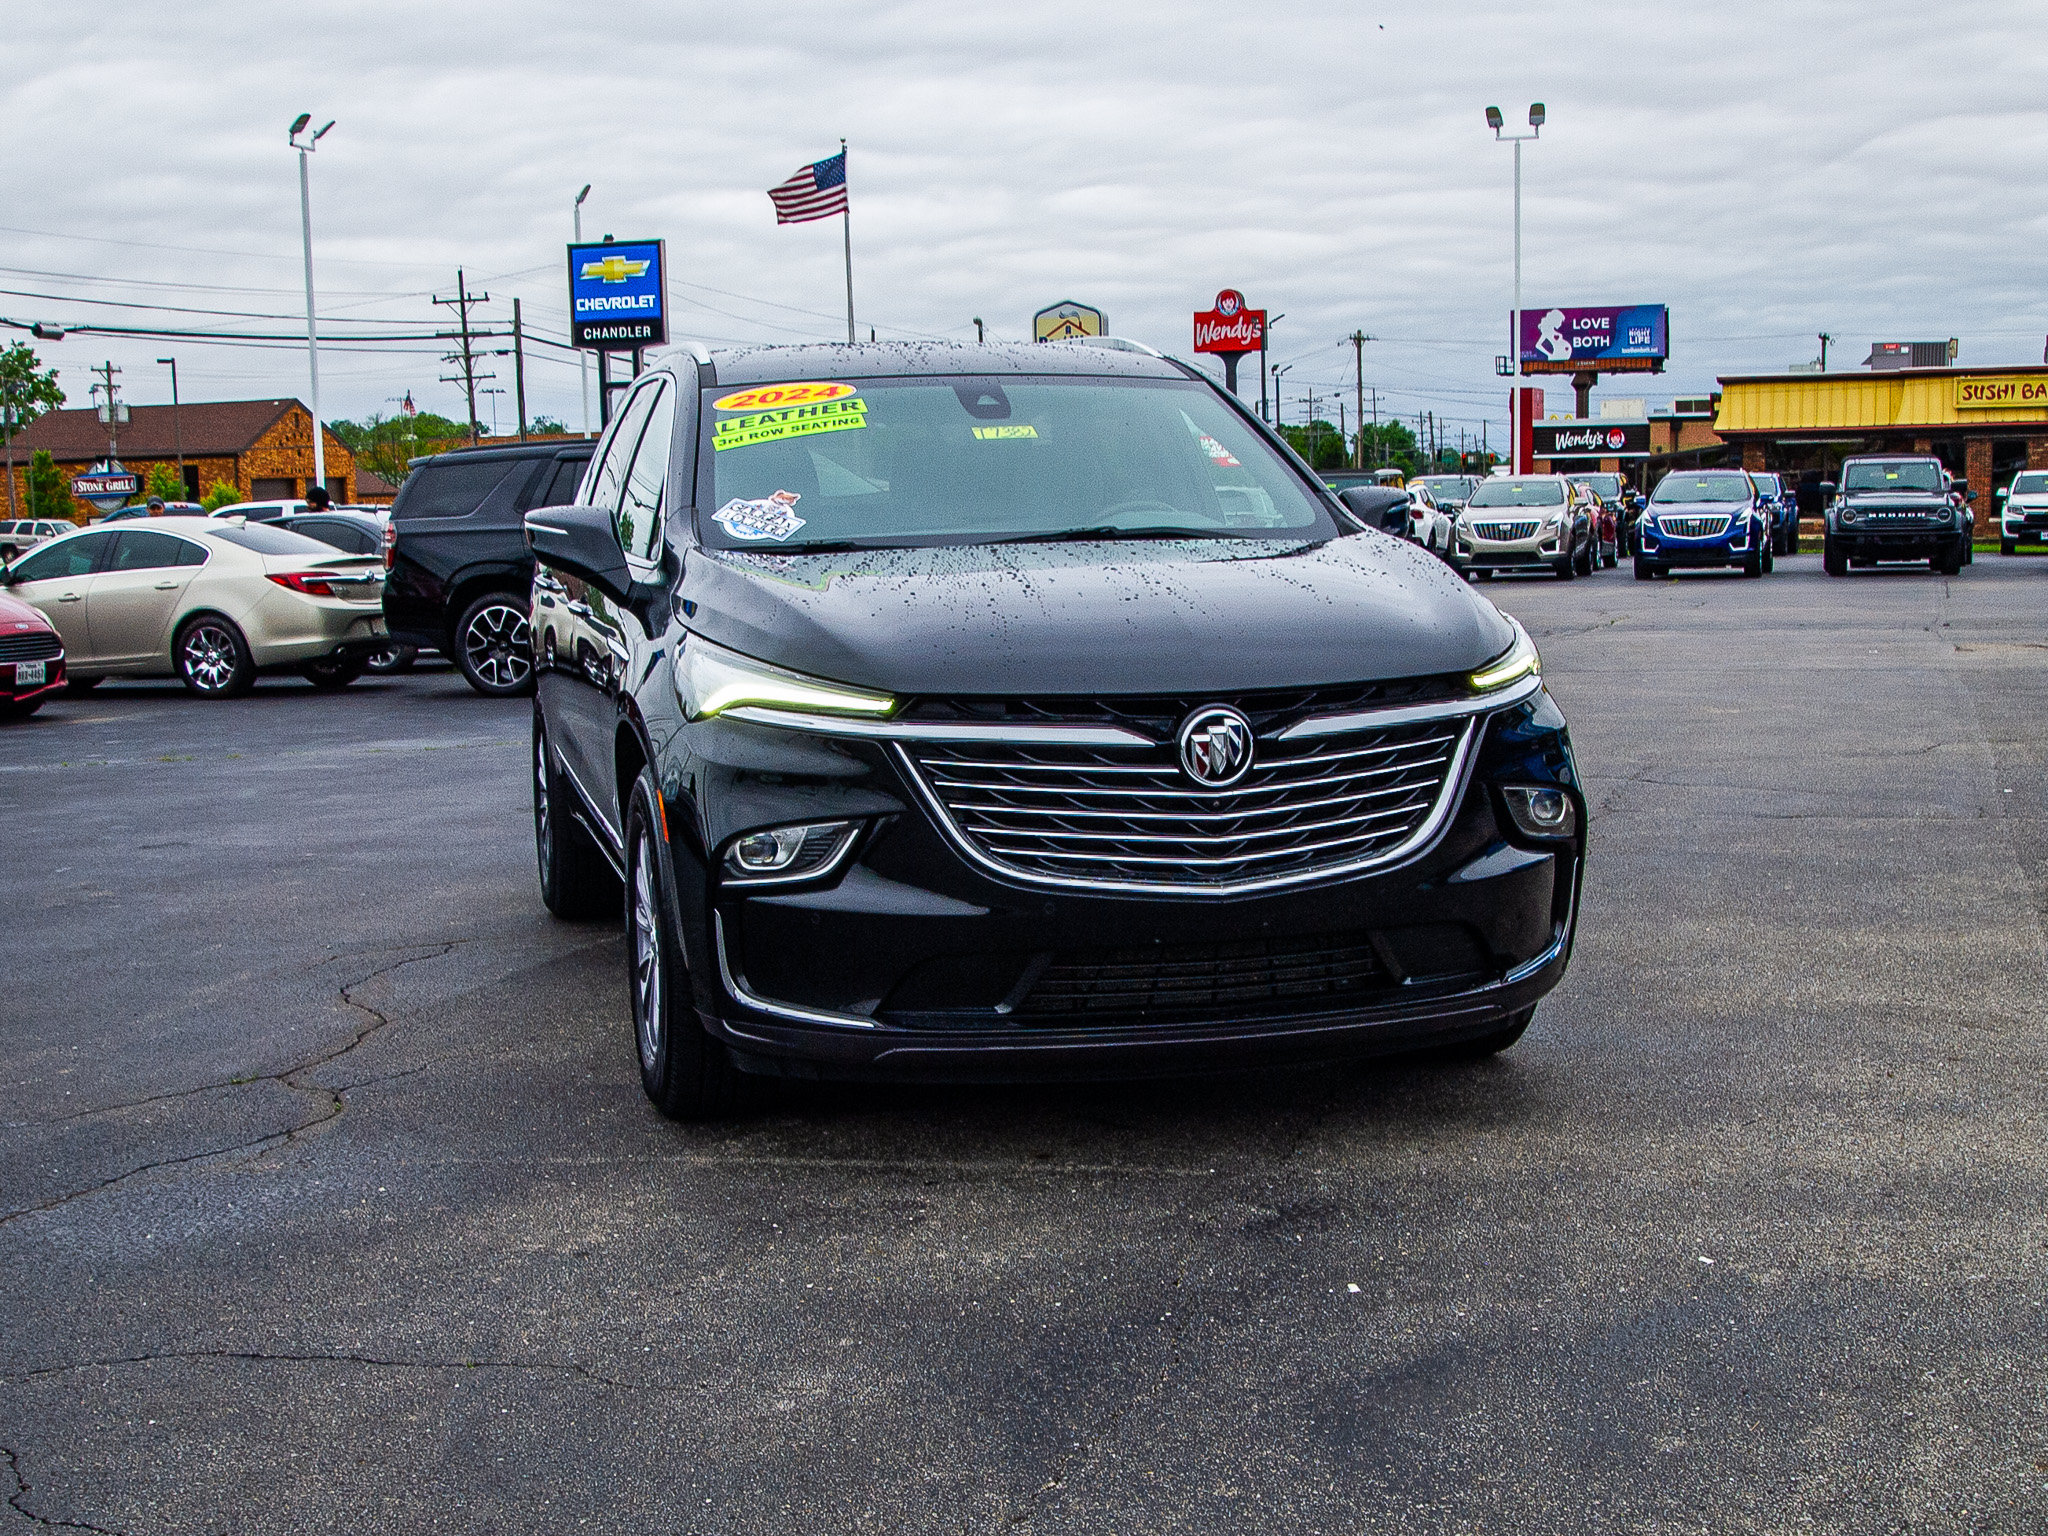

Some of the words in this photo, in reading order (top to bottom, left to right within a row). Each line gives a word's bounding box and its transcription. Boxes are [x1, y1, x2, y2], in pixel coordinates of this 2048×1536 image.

[576, 294, 656, 312] CHEVROLET
[583, 325, 651, 339] CHANDLER
[1196, 315, 1261, 347] Wendy's
[1572, 317, 1610, 330] LOVE
[1572, 335, 1610, 348] BOTH
[1629, 336, 1651, 345] LIFE
[730, 386, 840, 409] 2024
[1962, 384, 2015, 400] SUSHI
[2022, 383, 2048, 399] BA
[721, 401, 861, 433] LEATHER
[718, 435, 743, 447] 3rd
[749, 427, 784, 440] ROW
[790, 417, 861, 433] SEATING
[1555, 428, 1604, 451] Wendy's
[77, 481, 104, 492] STONE
[106, 479, 131, 491] GRILL
[731, 503, 791, 529] CARFAX
[732, 514, 788, 537] OWNER
